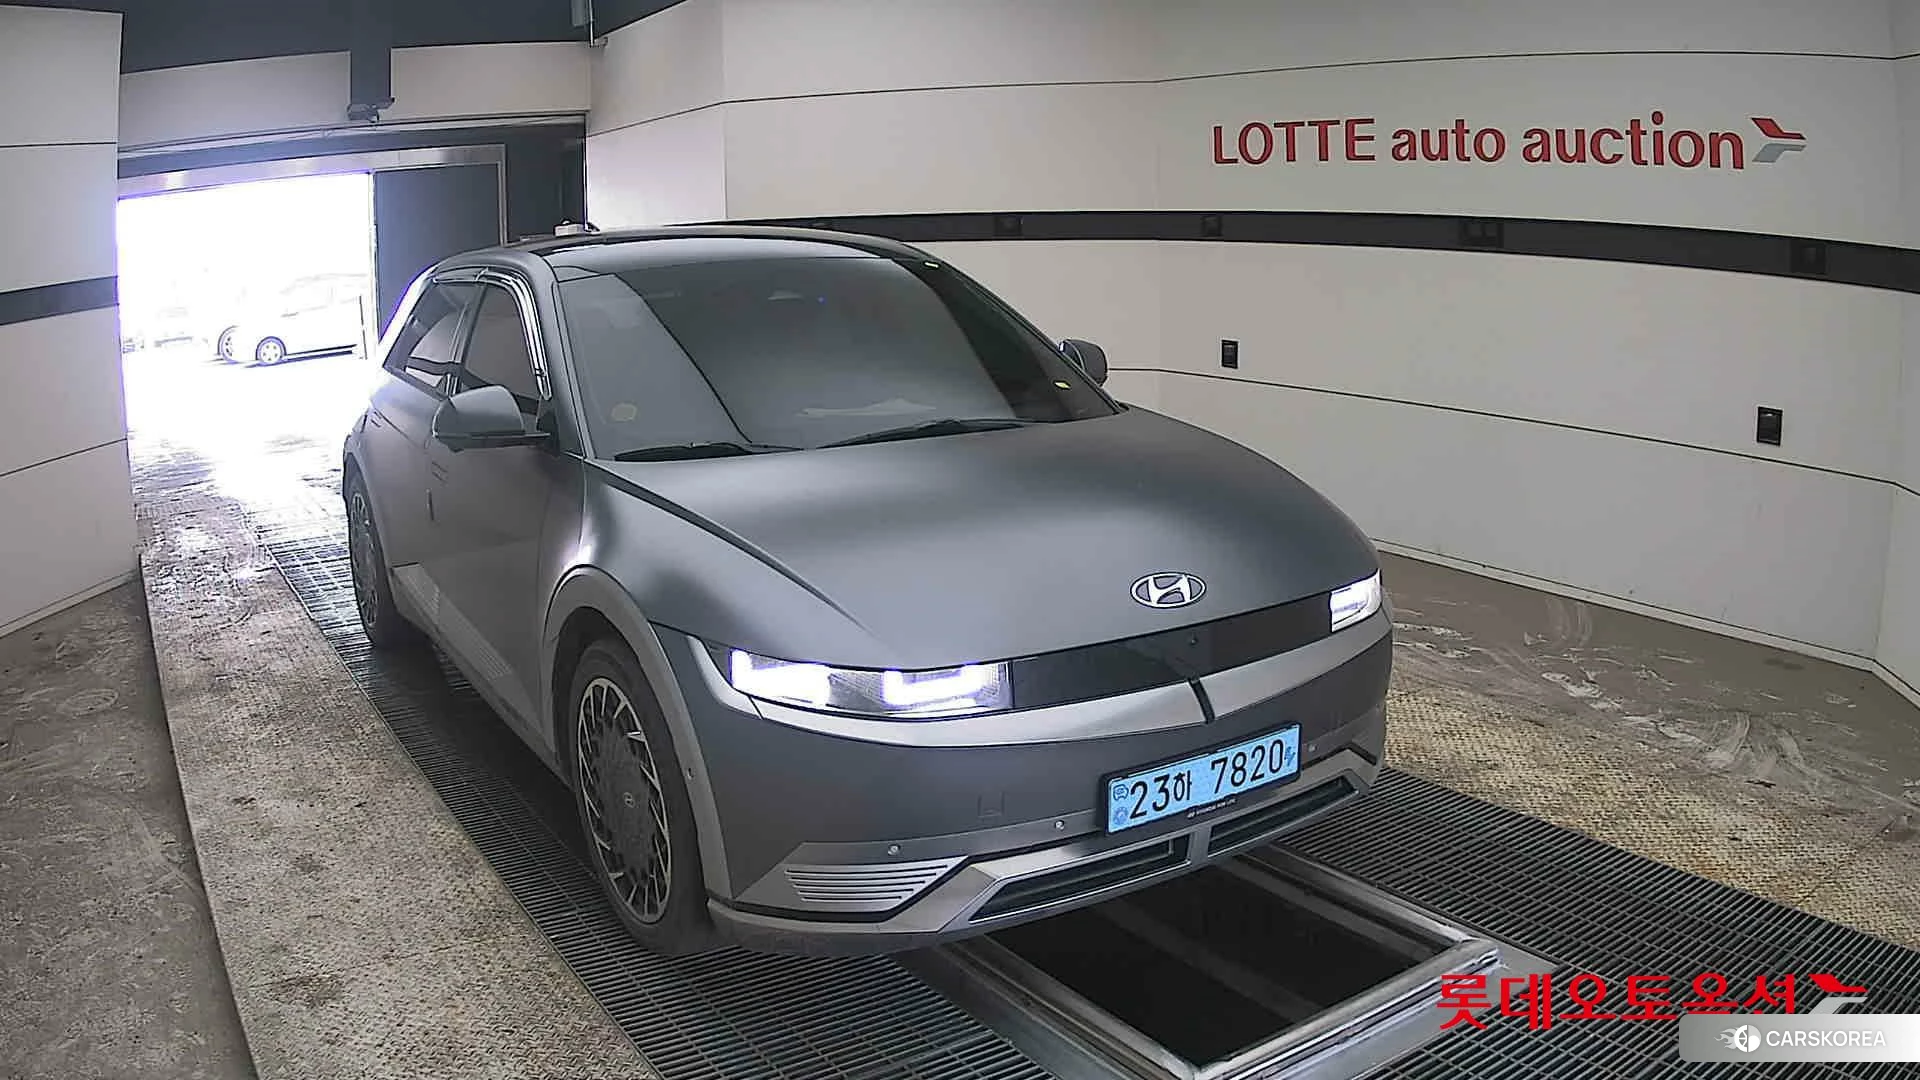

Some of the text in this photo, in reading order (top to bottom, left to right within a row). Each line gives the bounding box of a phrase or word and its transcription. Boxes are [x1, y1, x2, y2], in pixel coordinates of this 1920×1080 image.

[1212, 110, 1745, 170] LOTTE auto auction
[1130, 739, 1285, 819] 23하 7820
